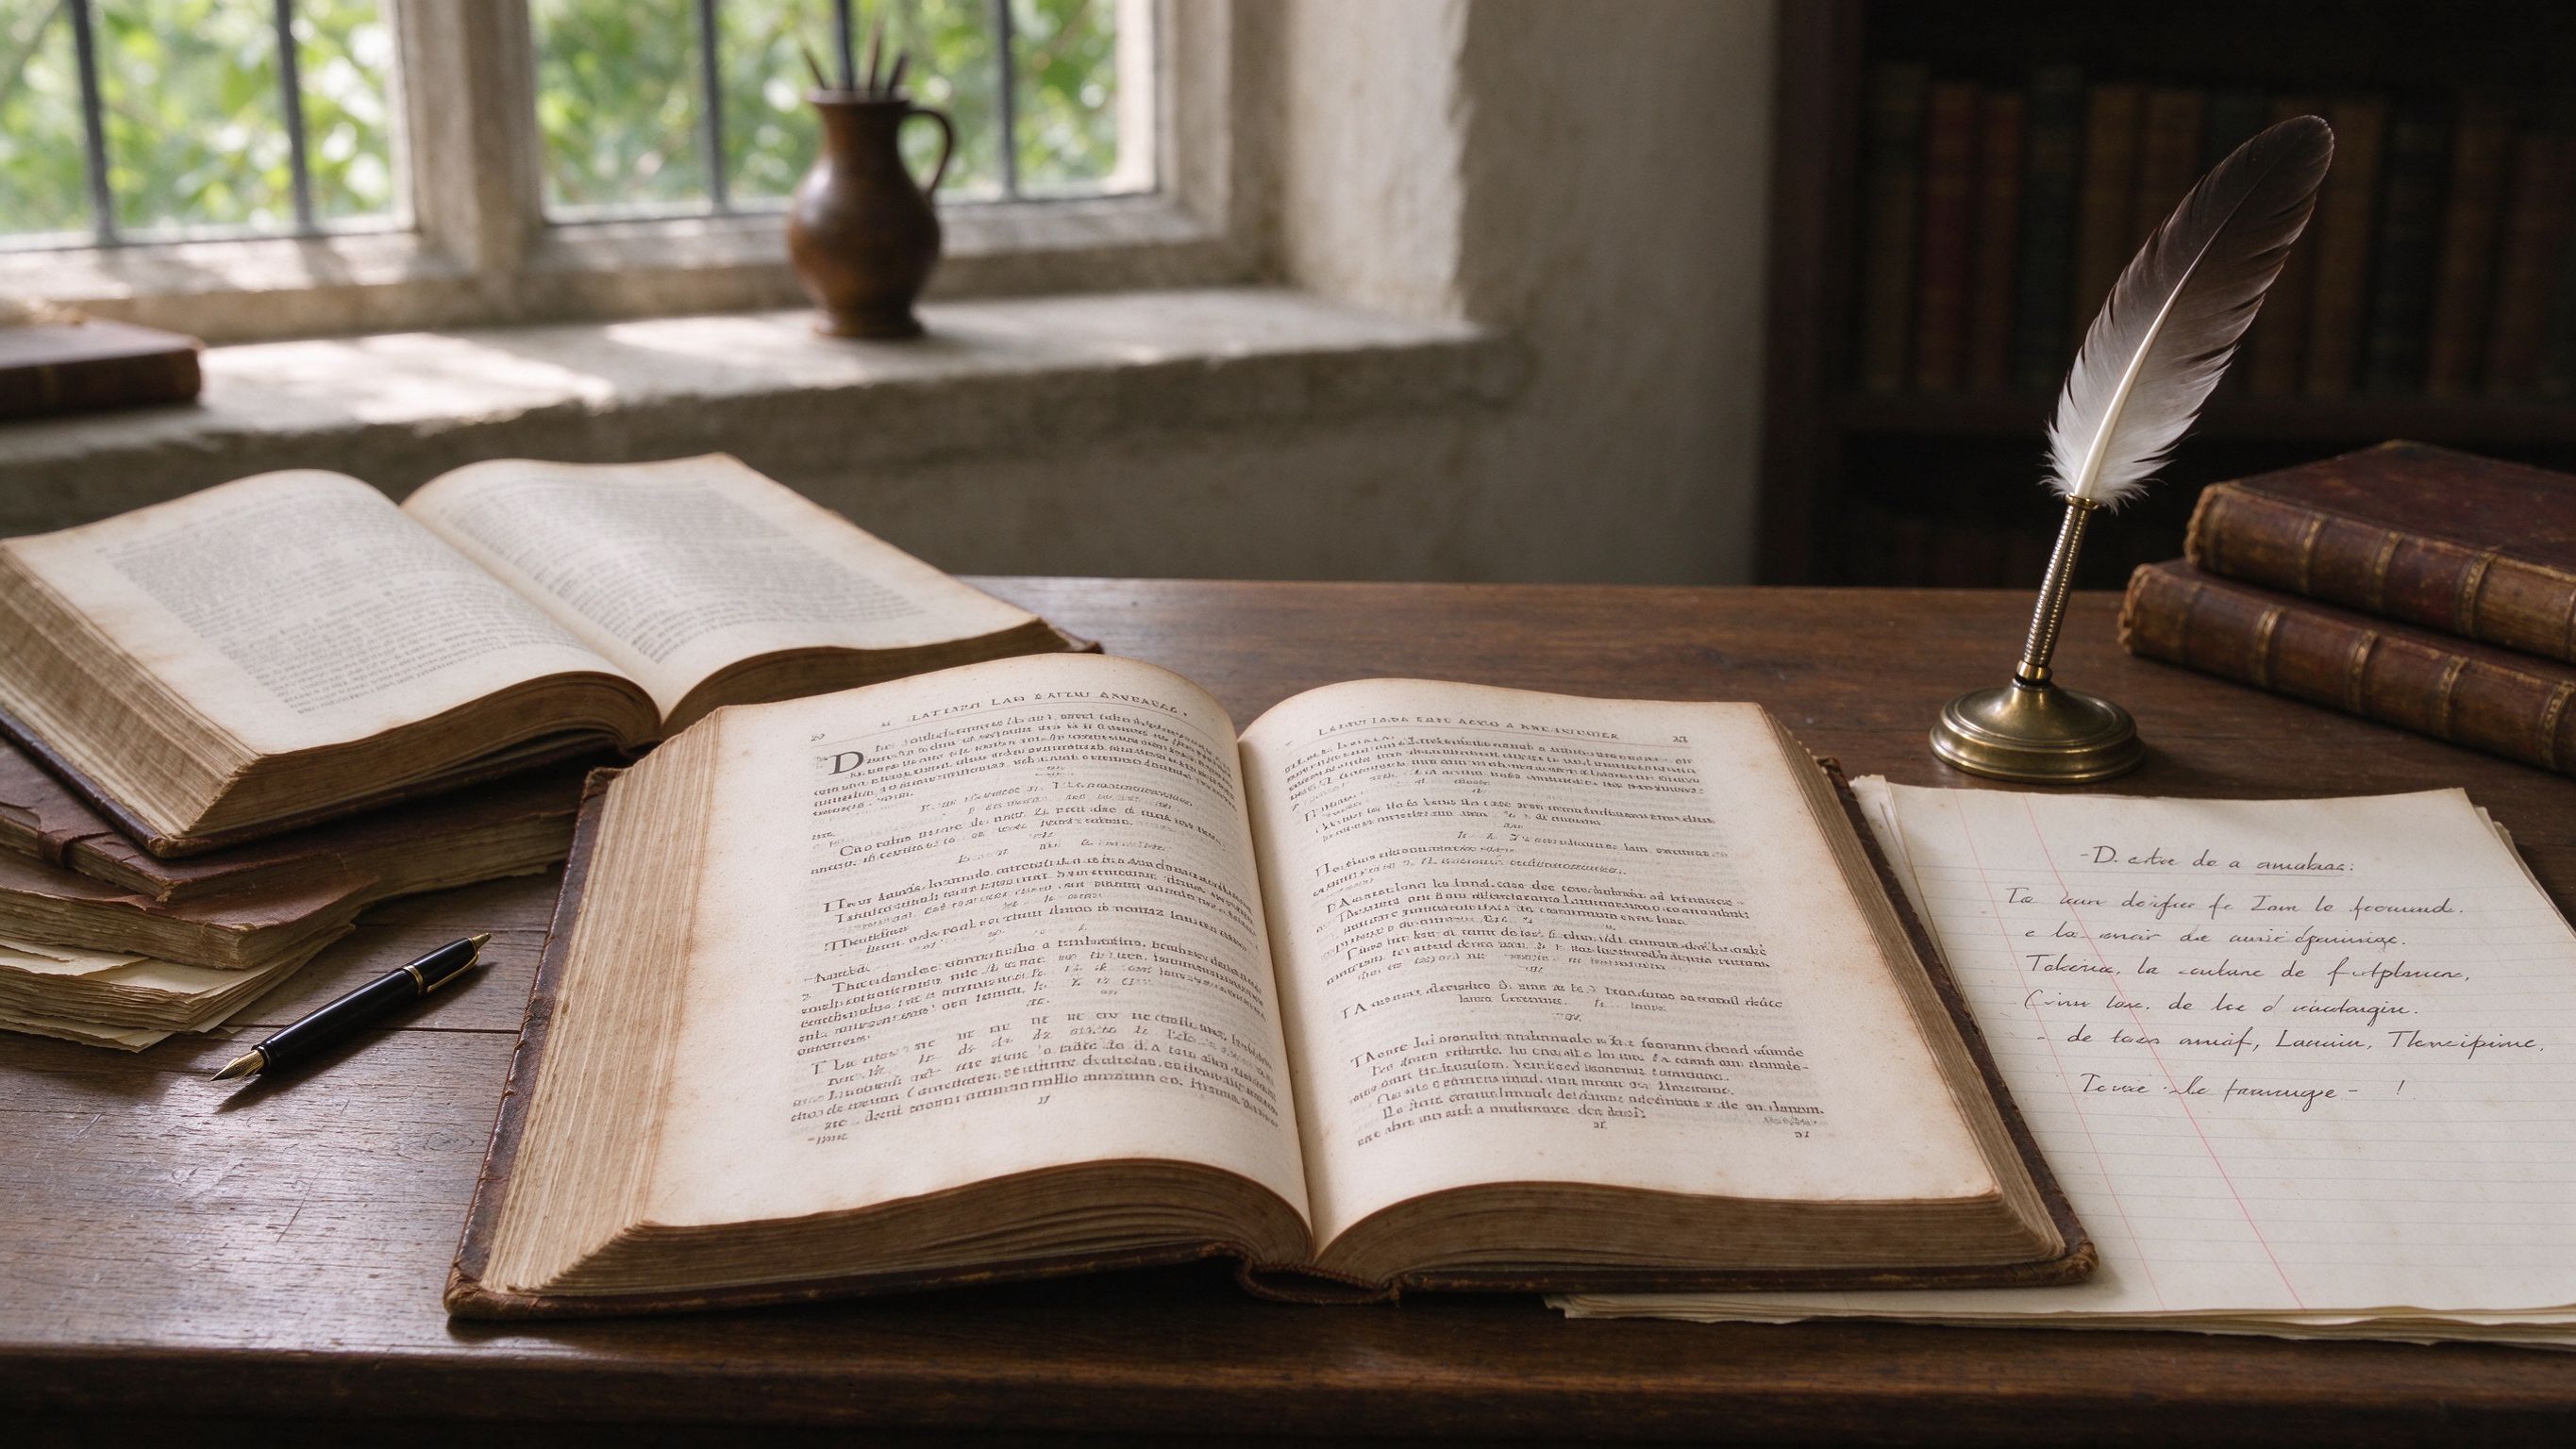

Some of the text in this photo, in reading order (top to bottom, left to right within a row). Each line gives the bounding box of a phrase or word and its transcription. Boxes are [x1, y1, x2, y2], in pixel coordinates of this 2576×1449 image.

[2282, 960, 2307, 977] de
[2168, 991, 2195, 1010] de
[2066, 1024, 2094, 1042] de
